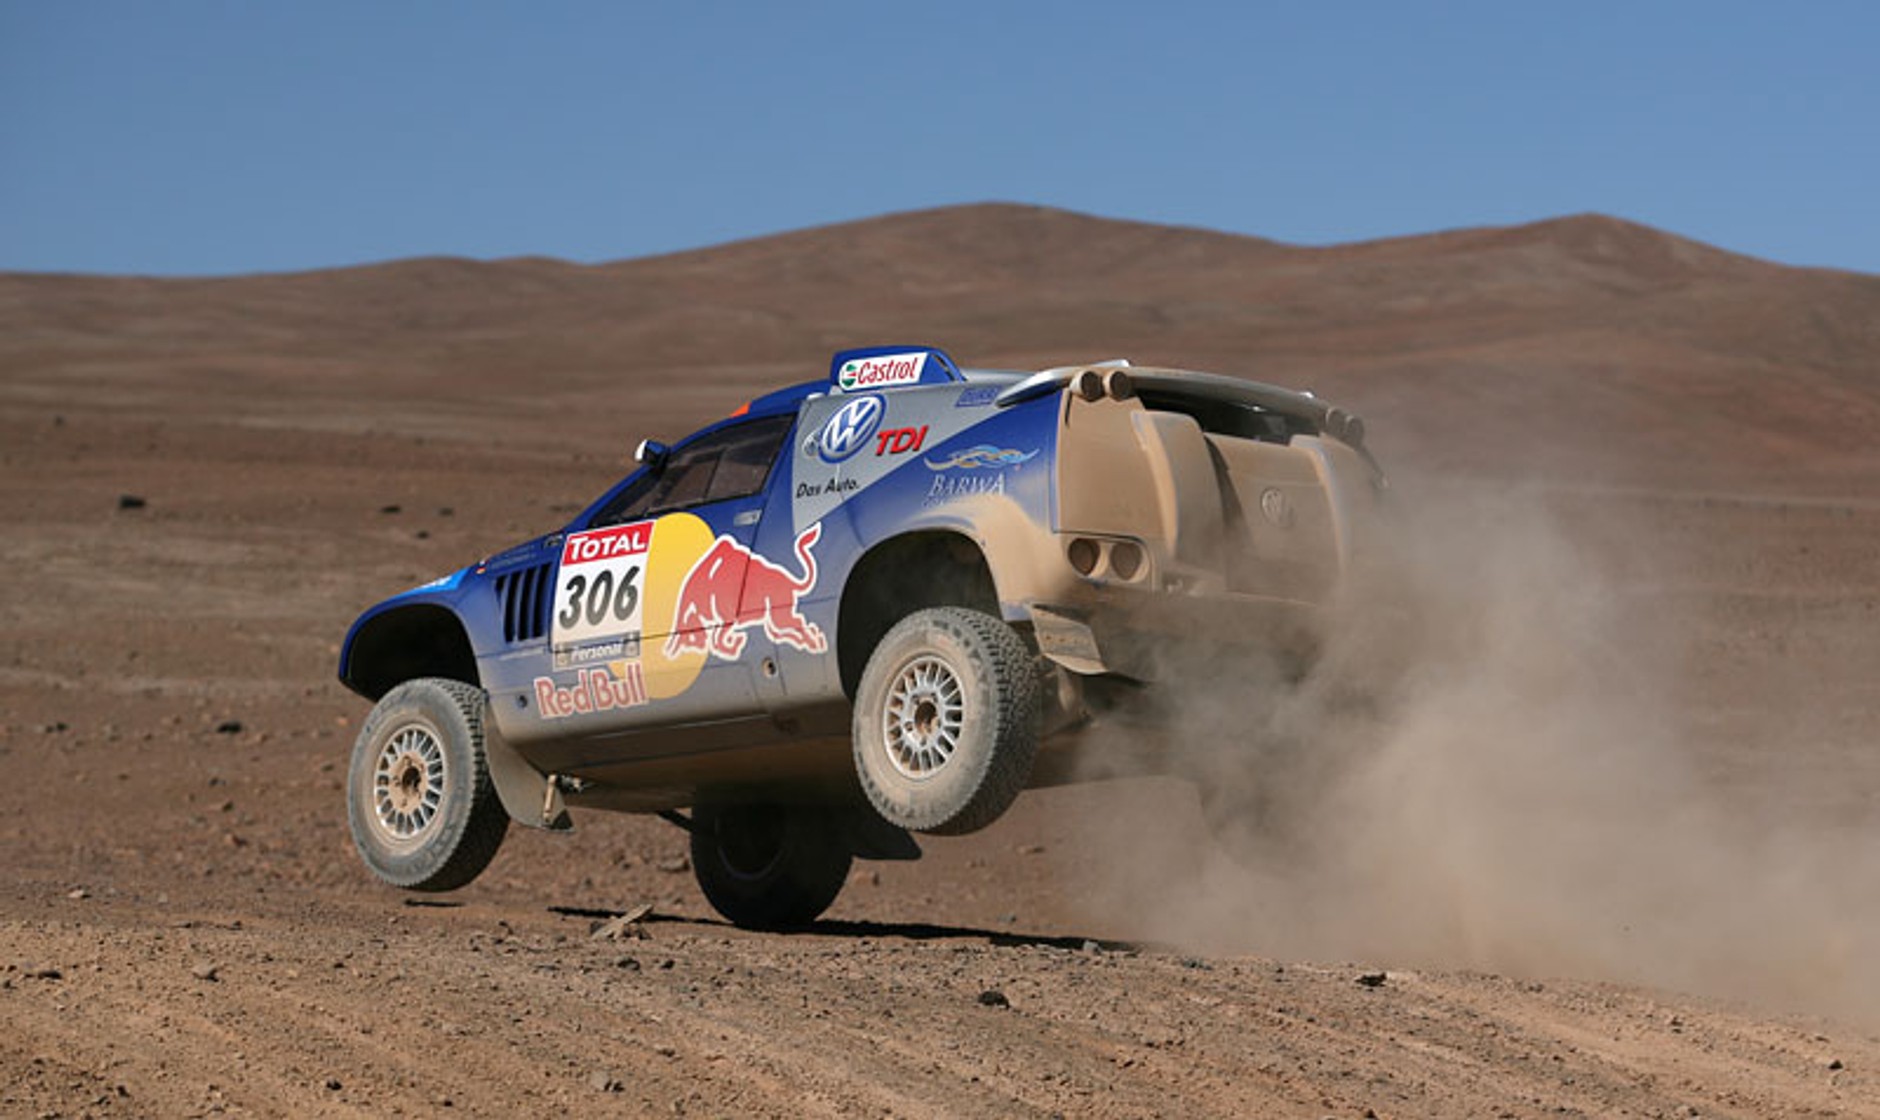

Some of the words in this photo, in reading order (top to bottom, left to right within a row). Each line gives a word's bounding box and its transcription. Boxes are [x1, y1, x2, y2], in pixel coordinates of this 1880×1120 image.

[857, 356, 919, 385] Castrol
[875, 425, 929, 457] TDI
[796, 481, 822, 499] Das
[824, 476, 860, 495] Auto.
[570, 529, 647, 561] TOTAL
[558, 565, 640, 629] 306
[534, 669, 592, 719] Red
[591, 662, 649, 710] Bull
